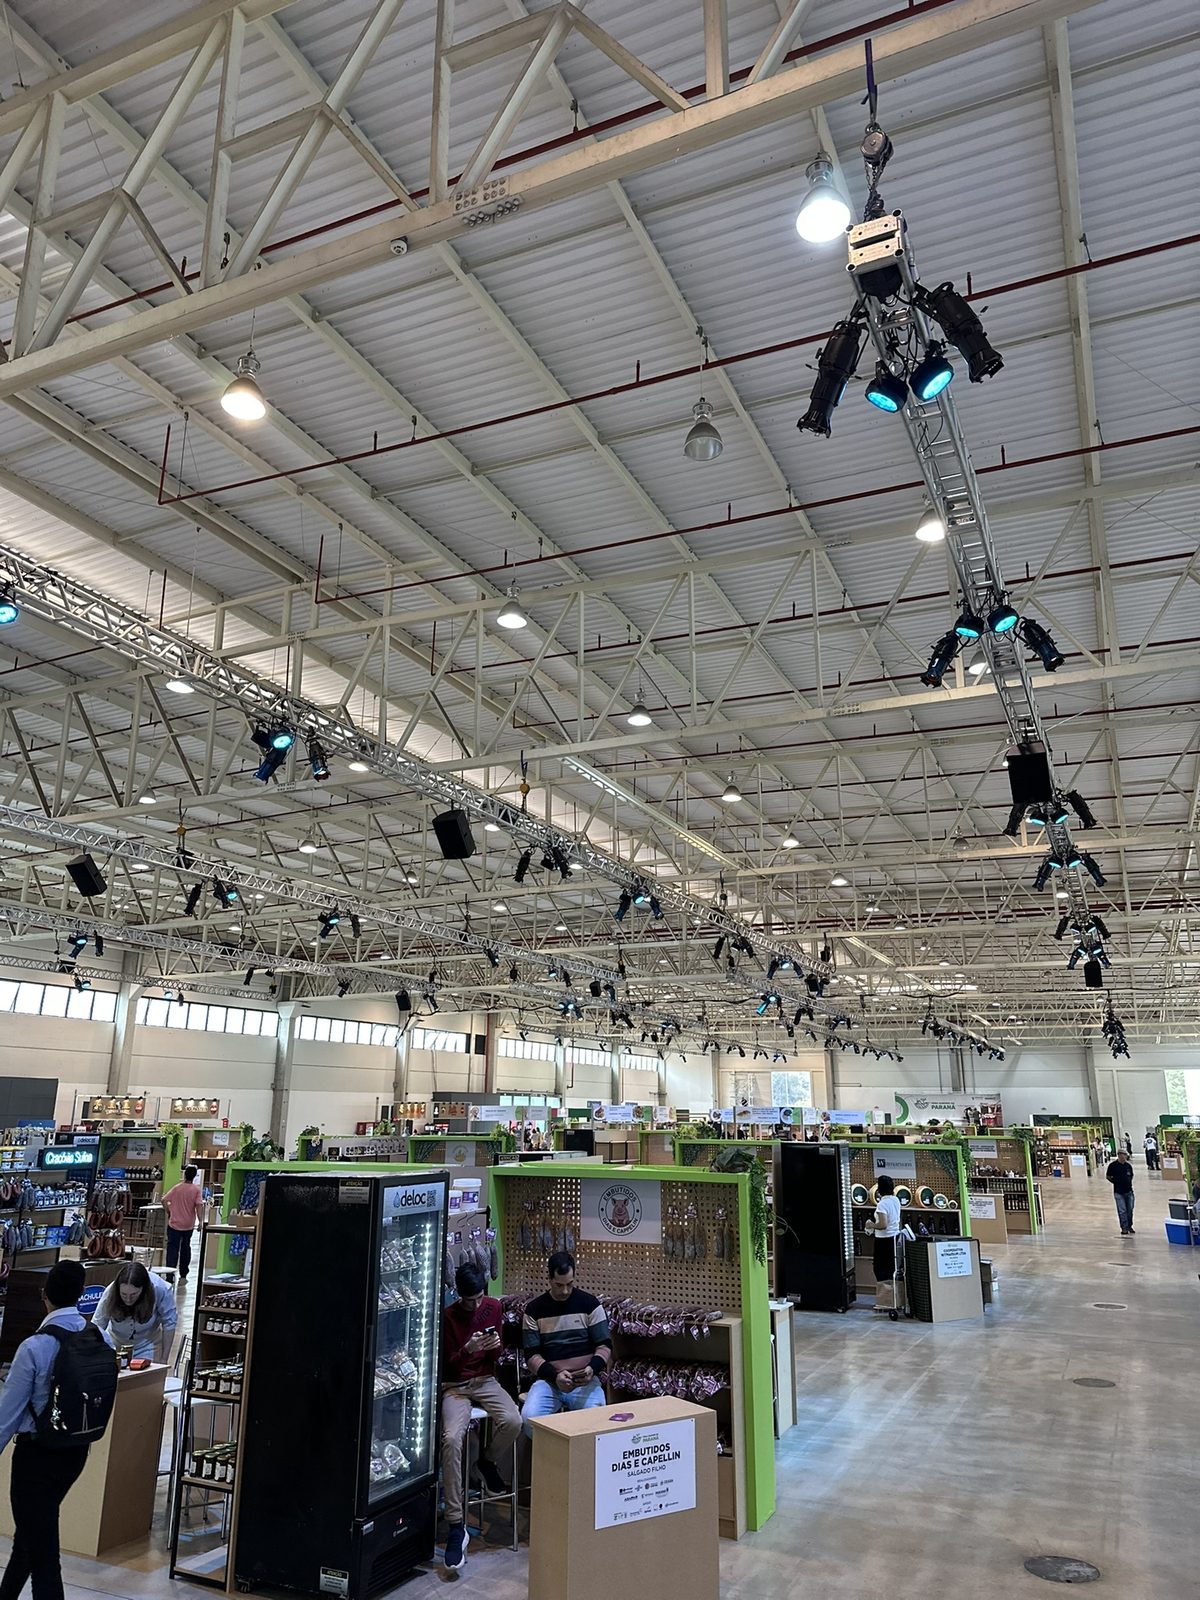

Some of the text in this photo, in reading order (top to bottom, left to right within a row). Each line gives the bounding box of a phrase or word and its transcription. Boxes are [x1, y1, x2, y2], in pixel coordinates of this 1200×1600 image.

[400, 1189, 426, 1207] deloc
[603, 1187, 637, 1202] EMBUTIDOS
[602, 1217, 612, 1230] DIAS
[622, 1442, 671, 1460] EMBUTIDOS
[611, 1450, 681, 1472] DIAS E CAPELLIN
[627, 1464, 667, 1477] SALGADO FILHO
